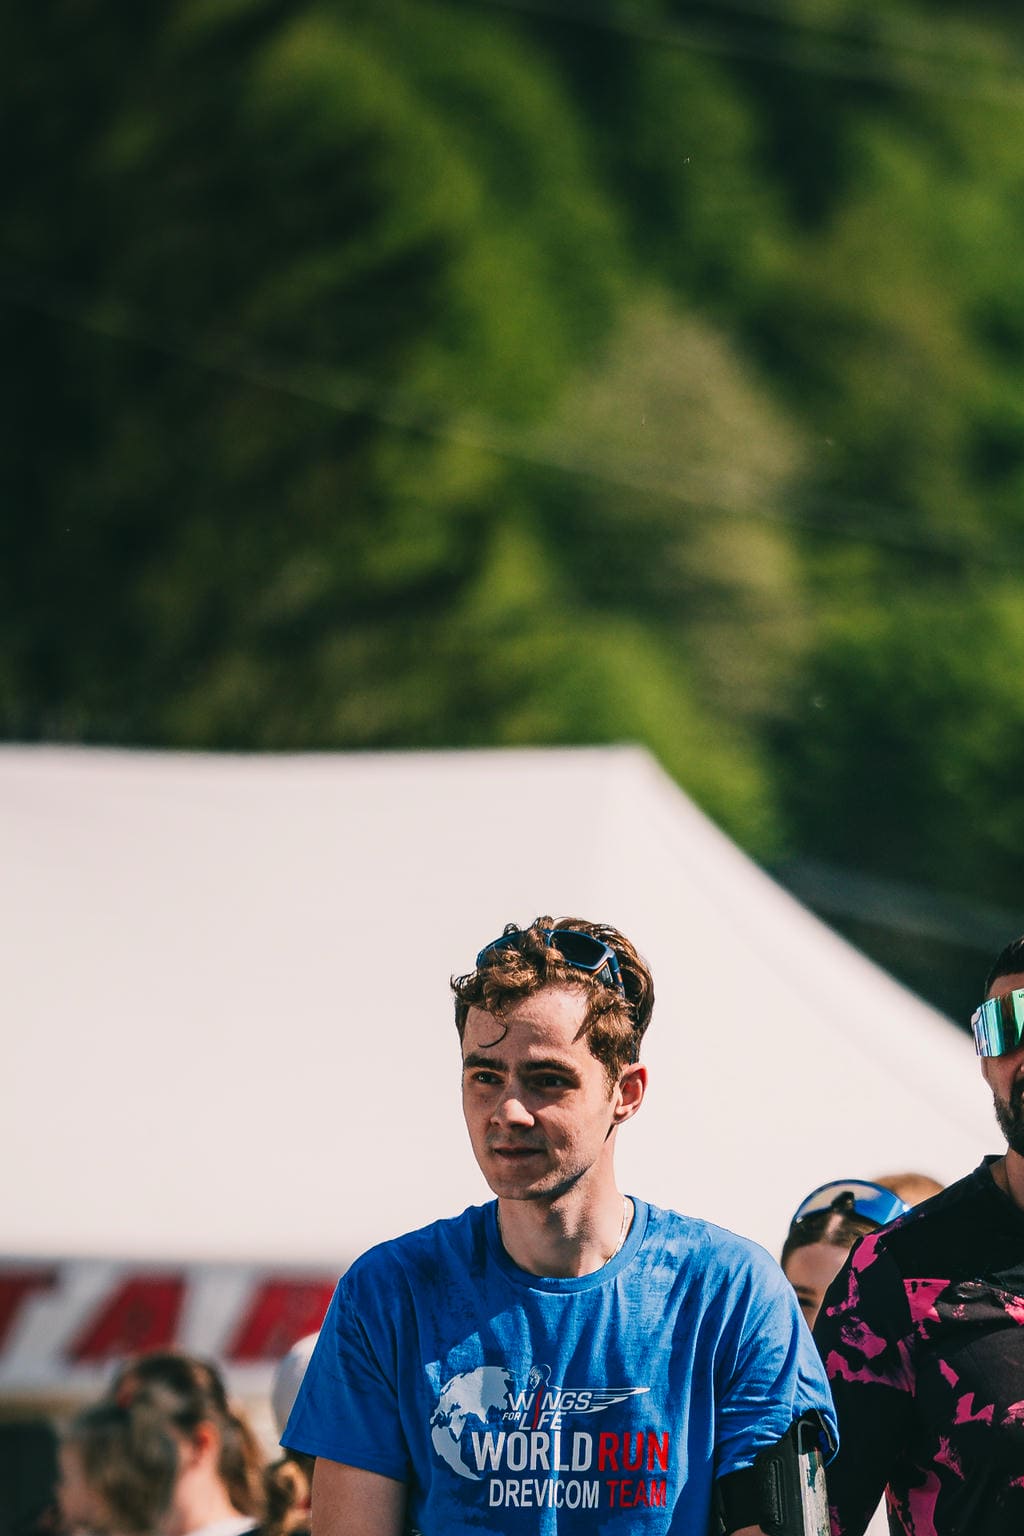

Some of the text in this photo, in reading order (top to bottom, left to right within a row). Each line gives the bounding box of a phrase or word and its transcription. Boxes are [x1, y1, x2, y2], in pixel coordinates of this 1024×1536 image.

[508, 1391, 593, 1411] WINGS
[502, 1411, 521, 1421] FOR
[518, 1411, 567, 1430] LIFE
[471, 1431, 670, 1472] WORLD RUN
[489, 1479, 668, 1509] DREVICOM TEAM
